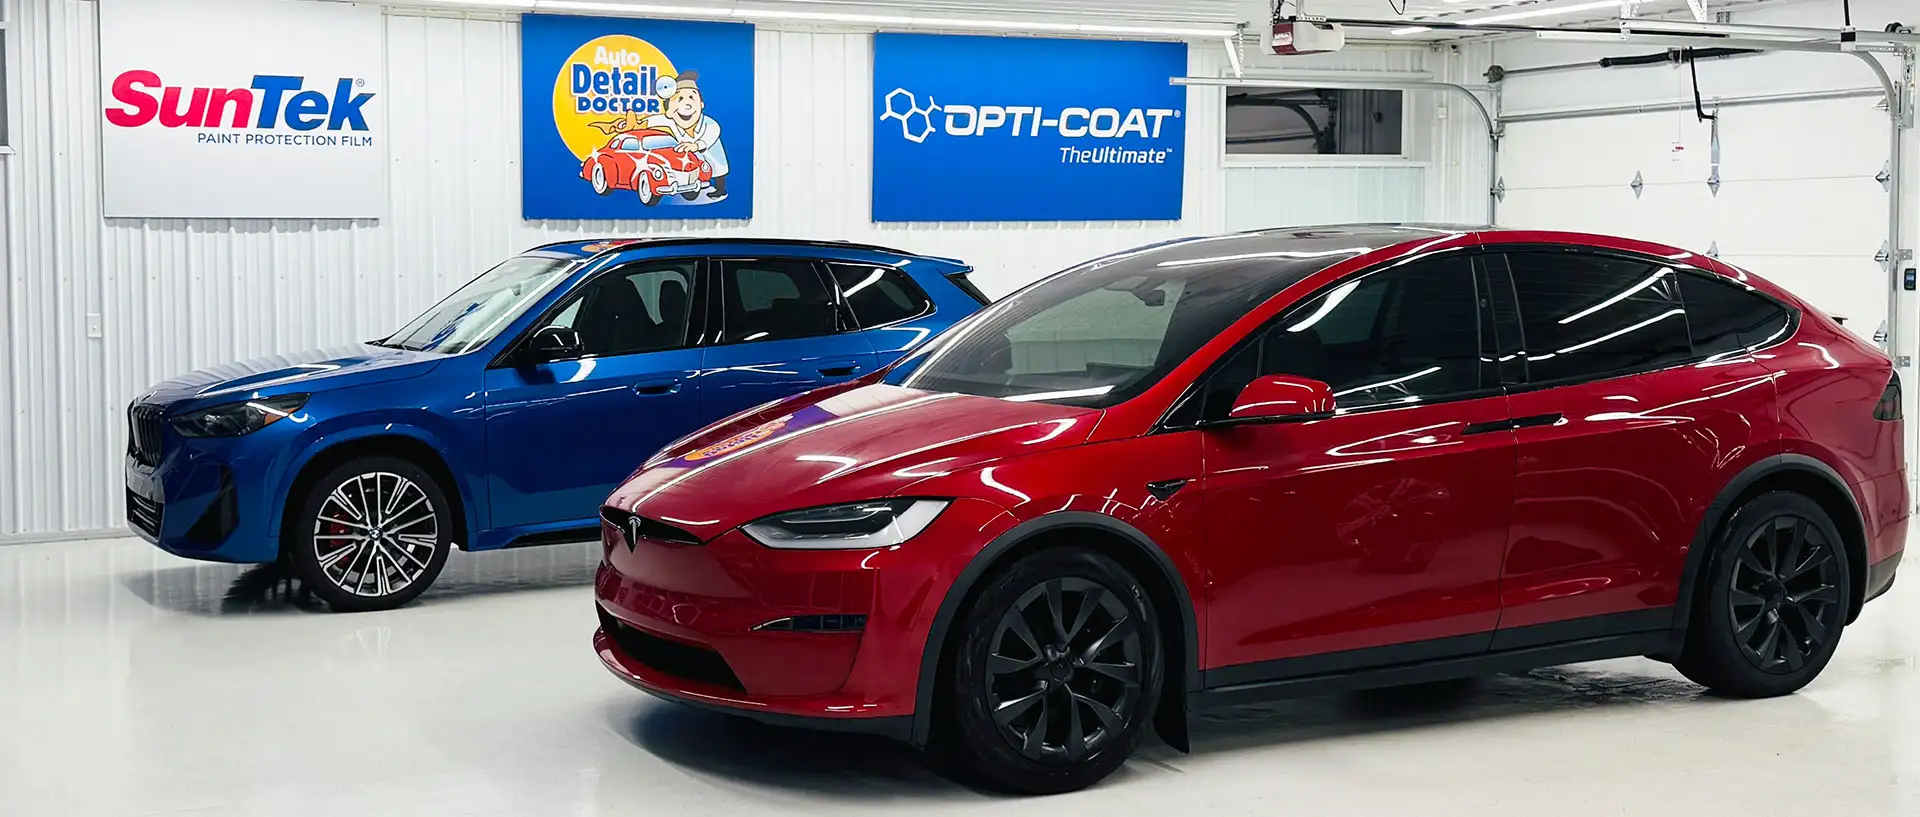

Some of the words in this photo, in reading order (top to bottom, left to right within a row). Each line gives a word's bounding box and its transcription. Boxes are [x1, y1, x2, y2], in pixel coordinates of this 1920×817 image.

[594, 45, 640, 66] Auto
[572, 63, 657, 96] Detail
[105, 69, 376, 131] SunTek
[577, 96, 660, 113] DOCTOR
[197, 132, 241, 144] PAINT
[246, 133, 337, 146] PROTECTION
[341, 135, 373, 147] FILM
